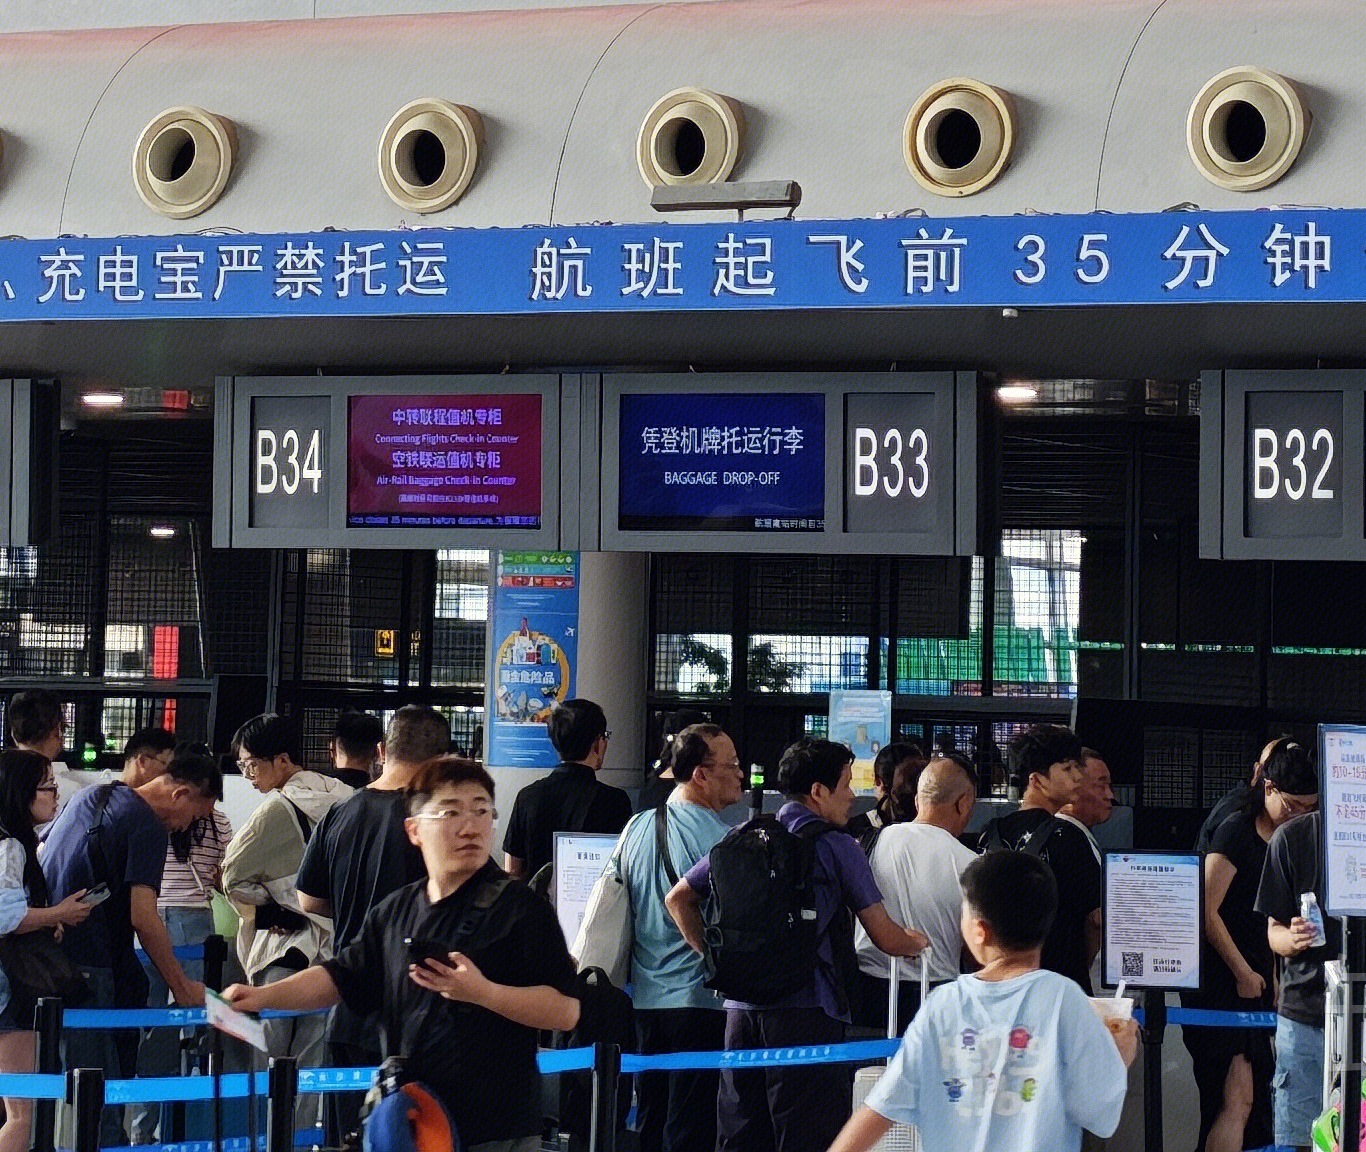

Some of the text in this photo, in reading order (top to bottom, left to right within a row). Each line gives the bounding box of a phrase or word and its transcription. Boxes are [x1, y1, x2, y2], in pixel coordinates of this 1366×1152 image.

[256, 429, 322, 495] B34
[641, 426, 804, 455] 凭登机牌托运行李
[854, 428, 929, 498] B33
[1253, 428, 1334, 500] B32
[664, 471, 781, 485] BAGGAGE DROP-OFF
